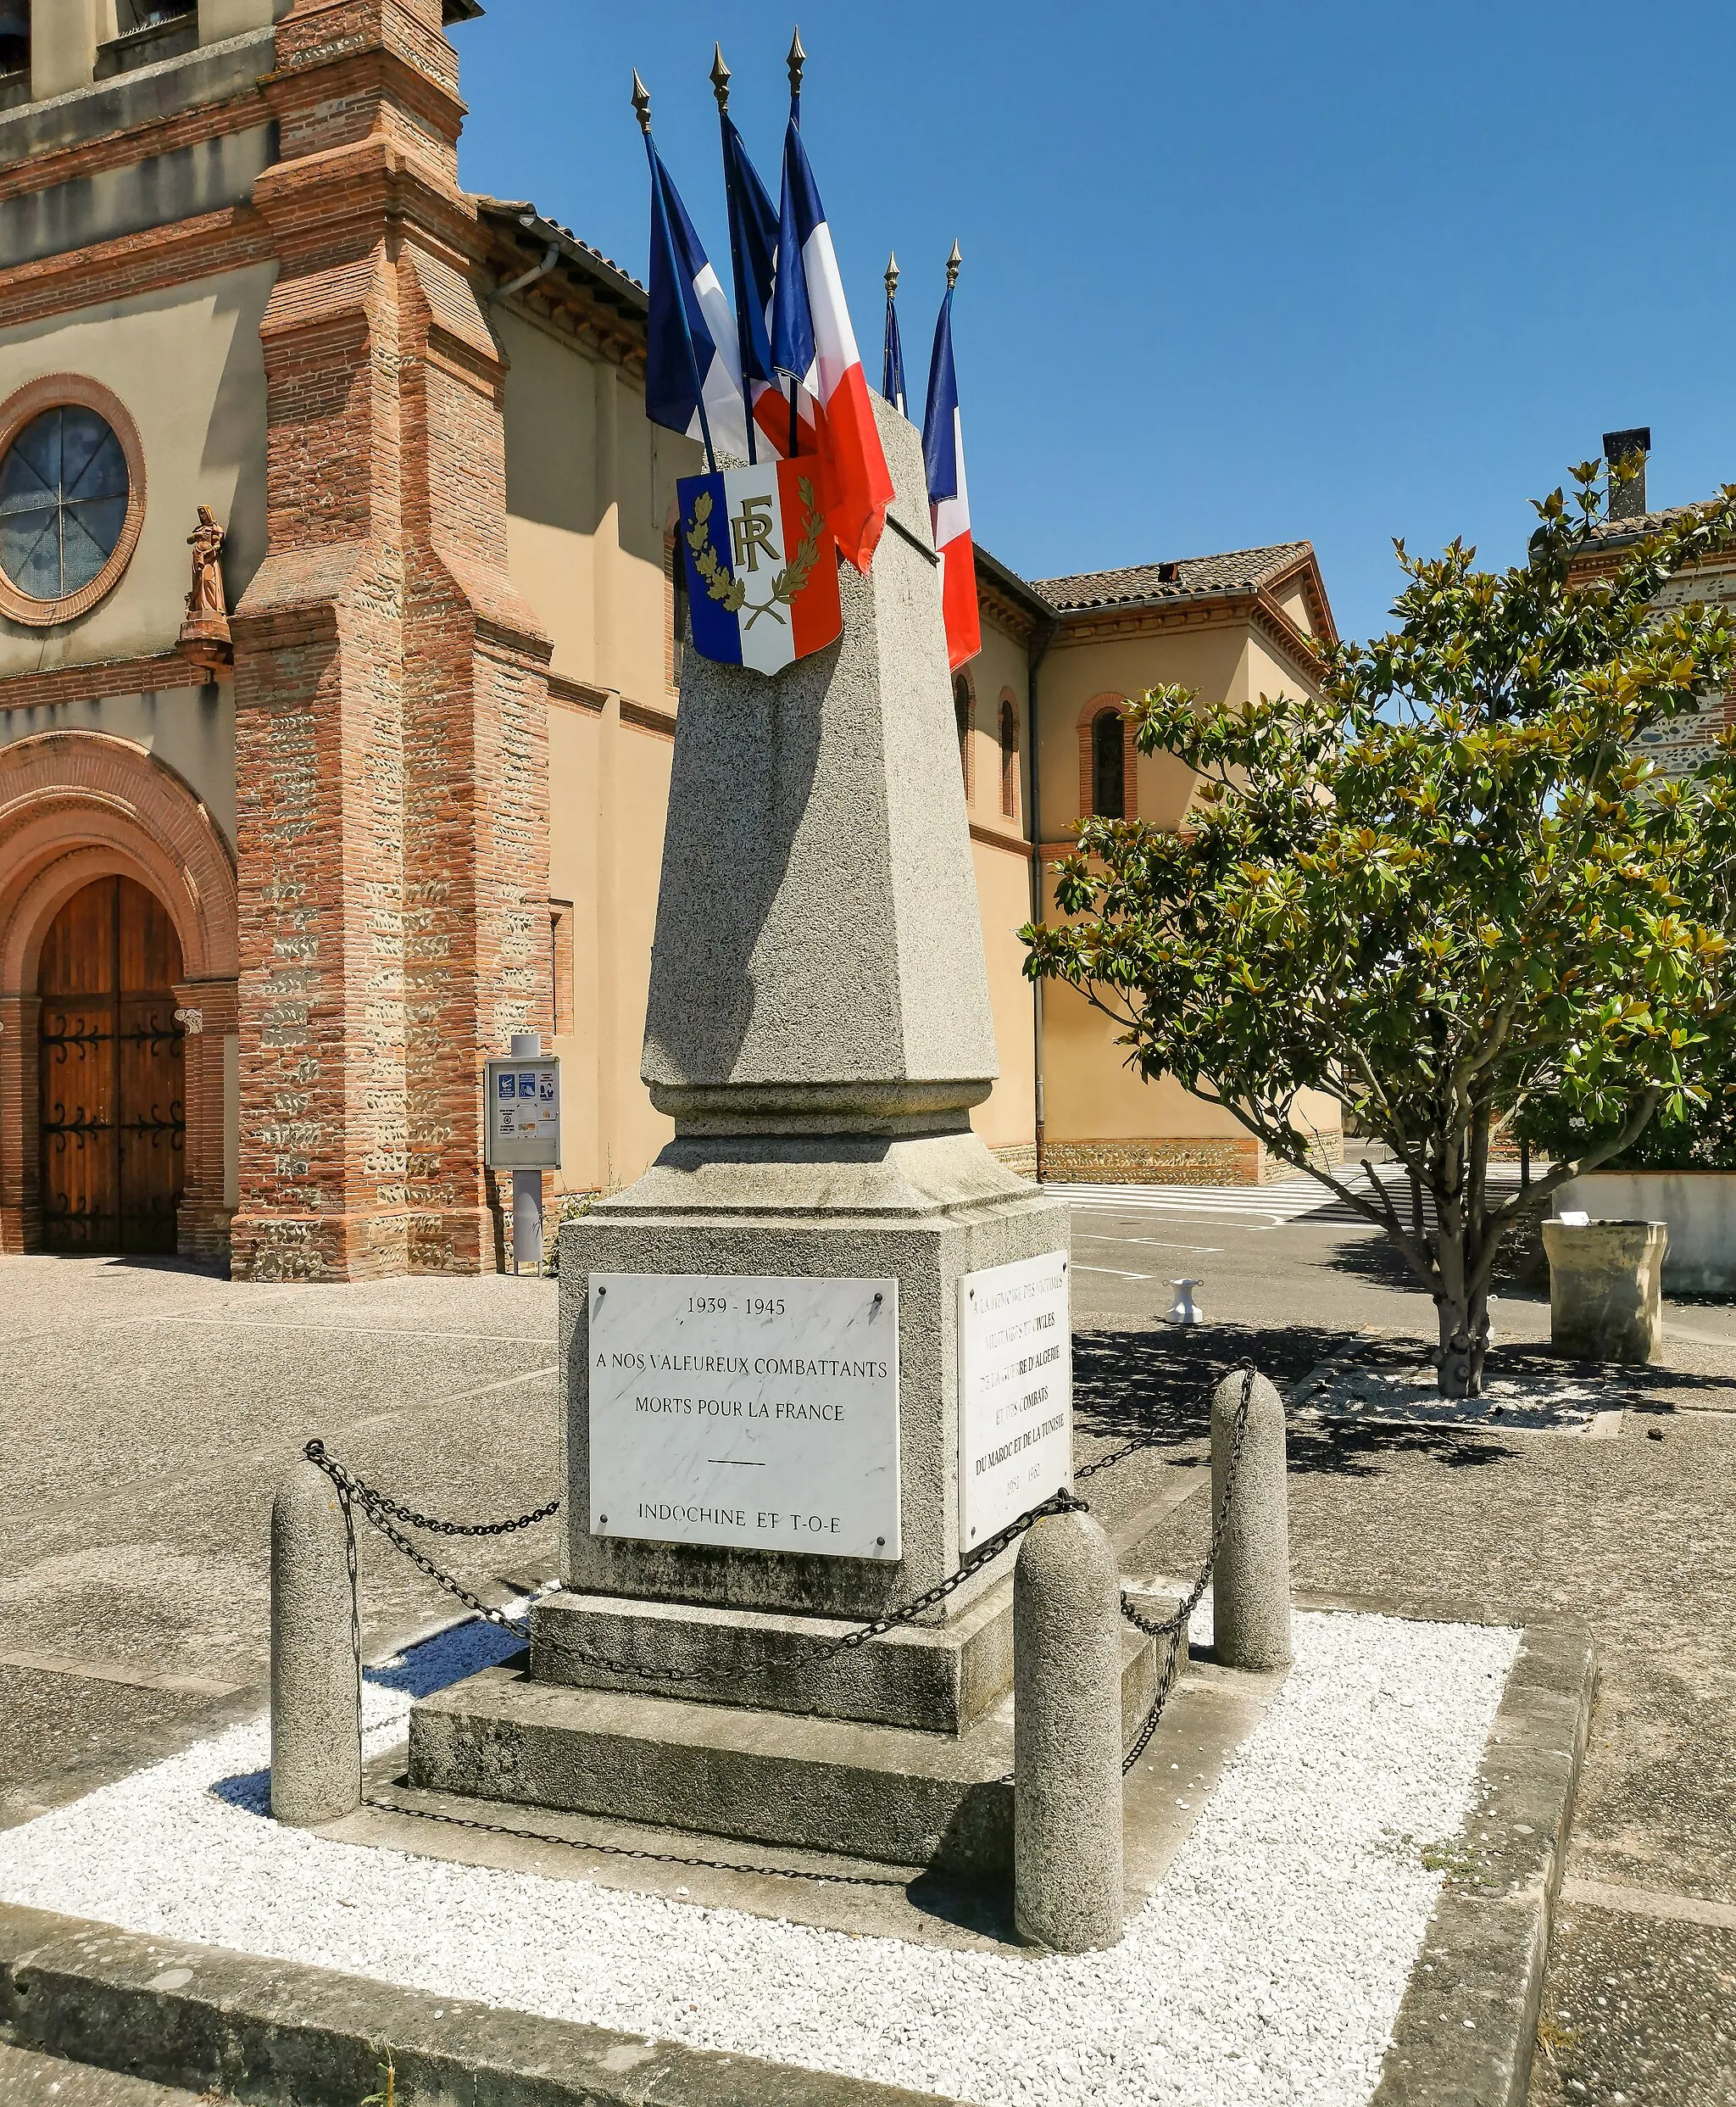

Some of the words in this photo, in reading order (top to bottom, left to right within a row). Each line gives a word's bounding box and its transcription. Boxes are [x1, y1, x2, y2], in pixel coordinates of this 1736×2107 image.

[1023, 1282, 1035, 1300] DES
[687, 1296, 726, 1315] 1939
[744, 1297, 786, 1316] 1945
[1032, 1312, 1055, 1333] CIVILES
[596, 1352, 607, 1368] A
[611, 1353, 645, 1369] NOS
[649, 1354, 749, 1374] VALEUREUX
[754, 1357, 888, 1379] COMBATTANTS
[1002, 1358, 1028, 1383] GUERRE
[635, 1396, 693, 1415] MORTS
[698, 1399, 743, 1417] POUR
[748, 1402, 770, 1419] LA
[776, 1402, 845, 1422] FRANCE
[1019, 1385, 1049, 1413] COMBATS
[976, 1455, 987, 1476] DU
[988, 1441, 1013, 1469] MAROC
[1014, 1436, 1022, 1454] ET
[1023, 1430, 1032, 1449] DE
[1032, 1425, 1041, 1443] LA
[1041, 1413, 1065, 1438] TUNISIE
[637, 1502, 747, 1527] INDOCHINE
[756, 1512, 780, 1529] ET
[790, 1513, 842, 1534] T-O-E
